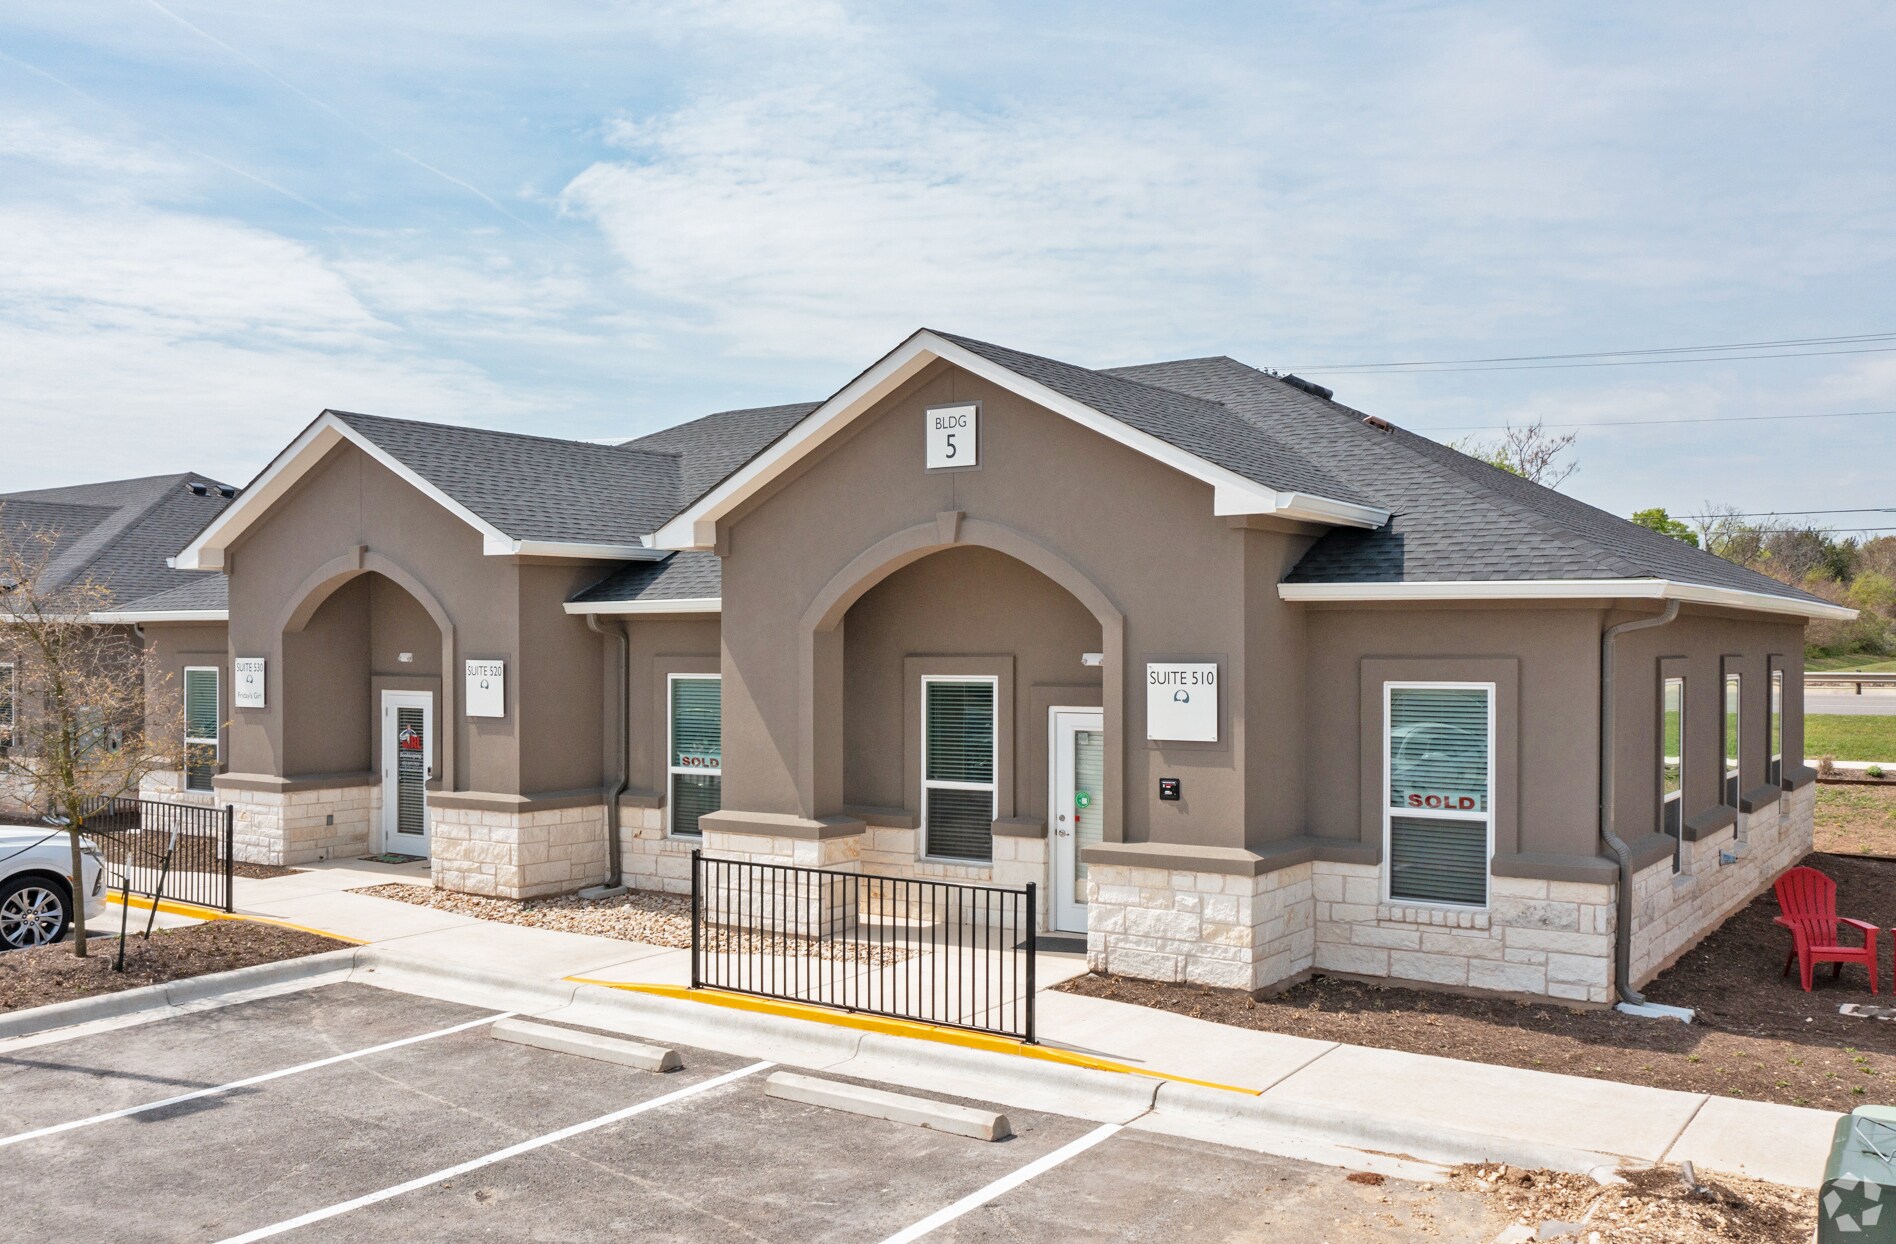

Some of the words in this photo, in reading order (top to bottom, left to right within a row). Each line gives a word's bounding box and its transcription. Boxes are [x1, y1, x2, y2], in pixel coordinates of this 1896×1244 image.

[935, 414, 967, 430] BLDG
[945, 433, 957, 459] 5
[236, 662, 252, 673] SUITE
[254, 662, 264, 673] 530
[467, 665, 488, 677] SUITE
[489, 665, 502, 677] 520
[1149, 670, 1188, 685] SUITE
[1191, 671, 1214, 685] 510
[682, 755, 720, 768] SOLD
[1407, 793, 1476, 810] SOLD
